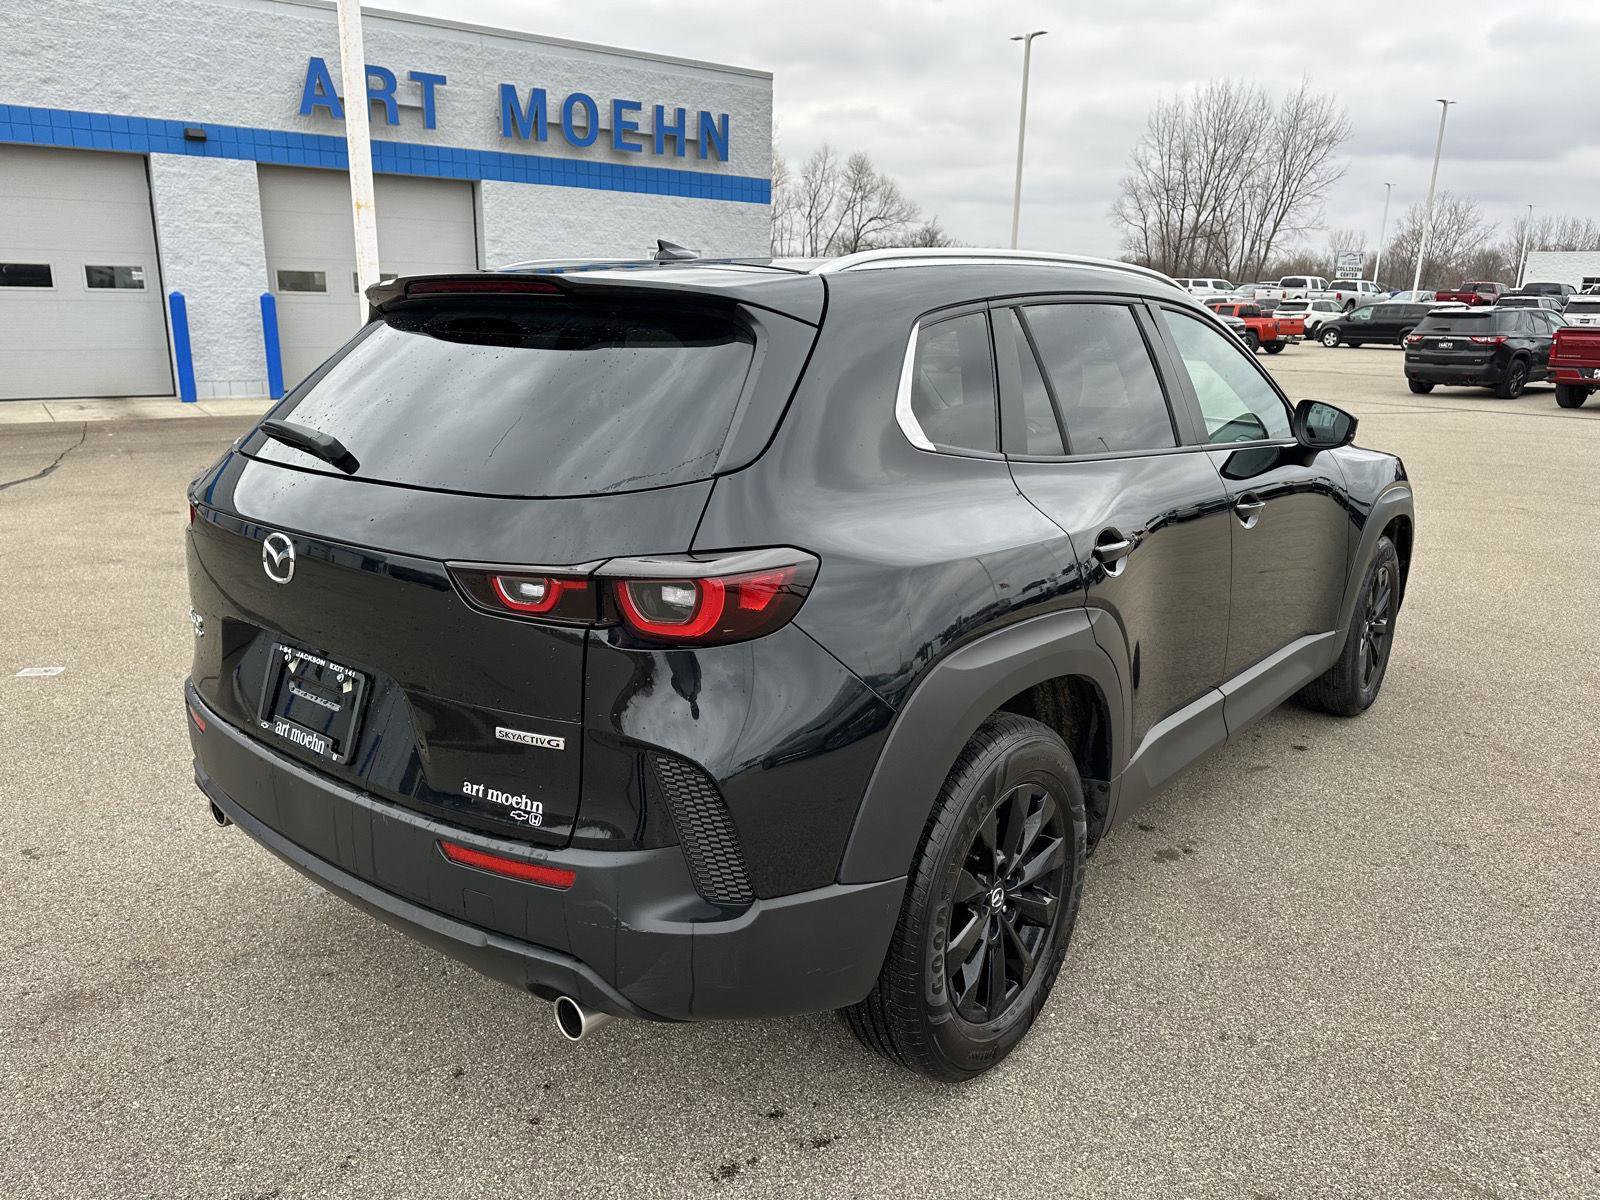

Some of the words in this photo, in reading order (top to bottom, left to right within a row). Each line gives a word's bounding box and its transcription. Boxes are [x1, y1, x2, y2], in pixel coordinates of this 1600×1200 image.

[300, 56, 447, 130] ART
[498, 83, 730, 161] MOEHN
[295, 651, 326, 666] JACKSON
[329, 662, 344, 673] EXIT
[344, 668, 356, 678] 141
[275, 718, 290, 738] art
[289, 724, 325, 755] moehn
[462, 781, 486, 798] art
[486, 788, 543, 815] moehn
